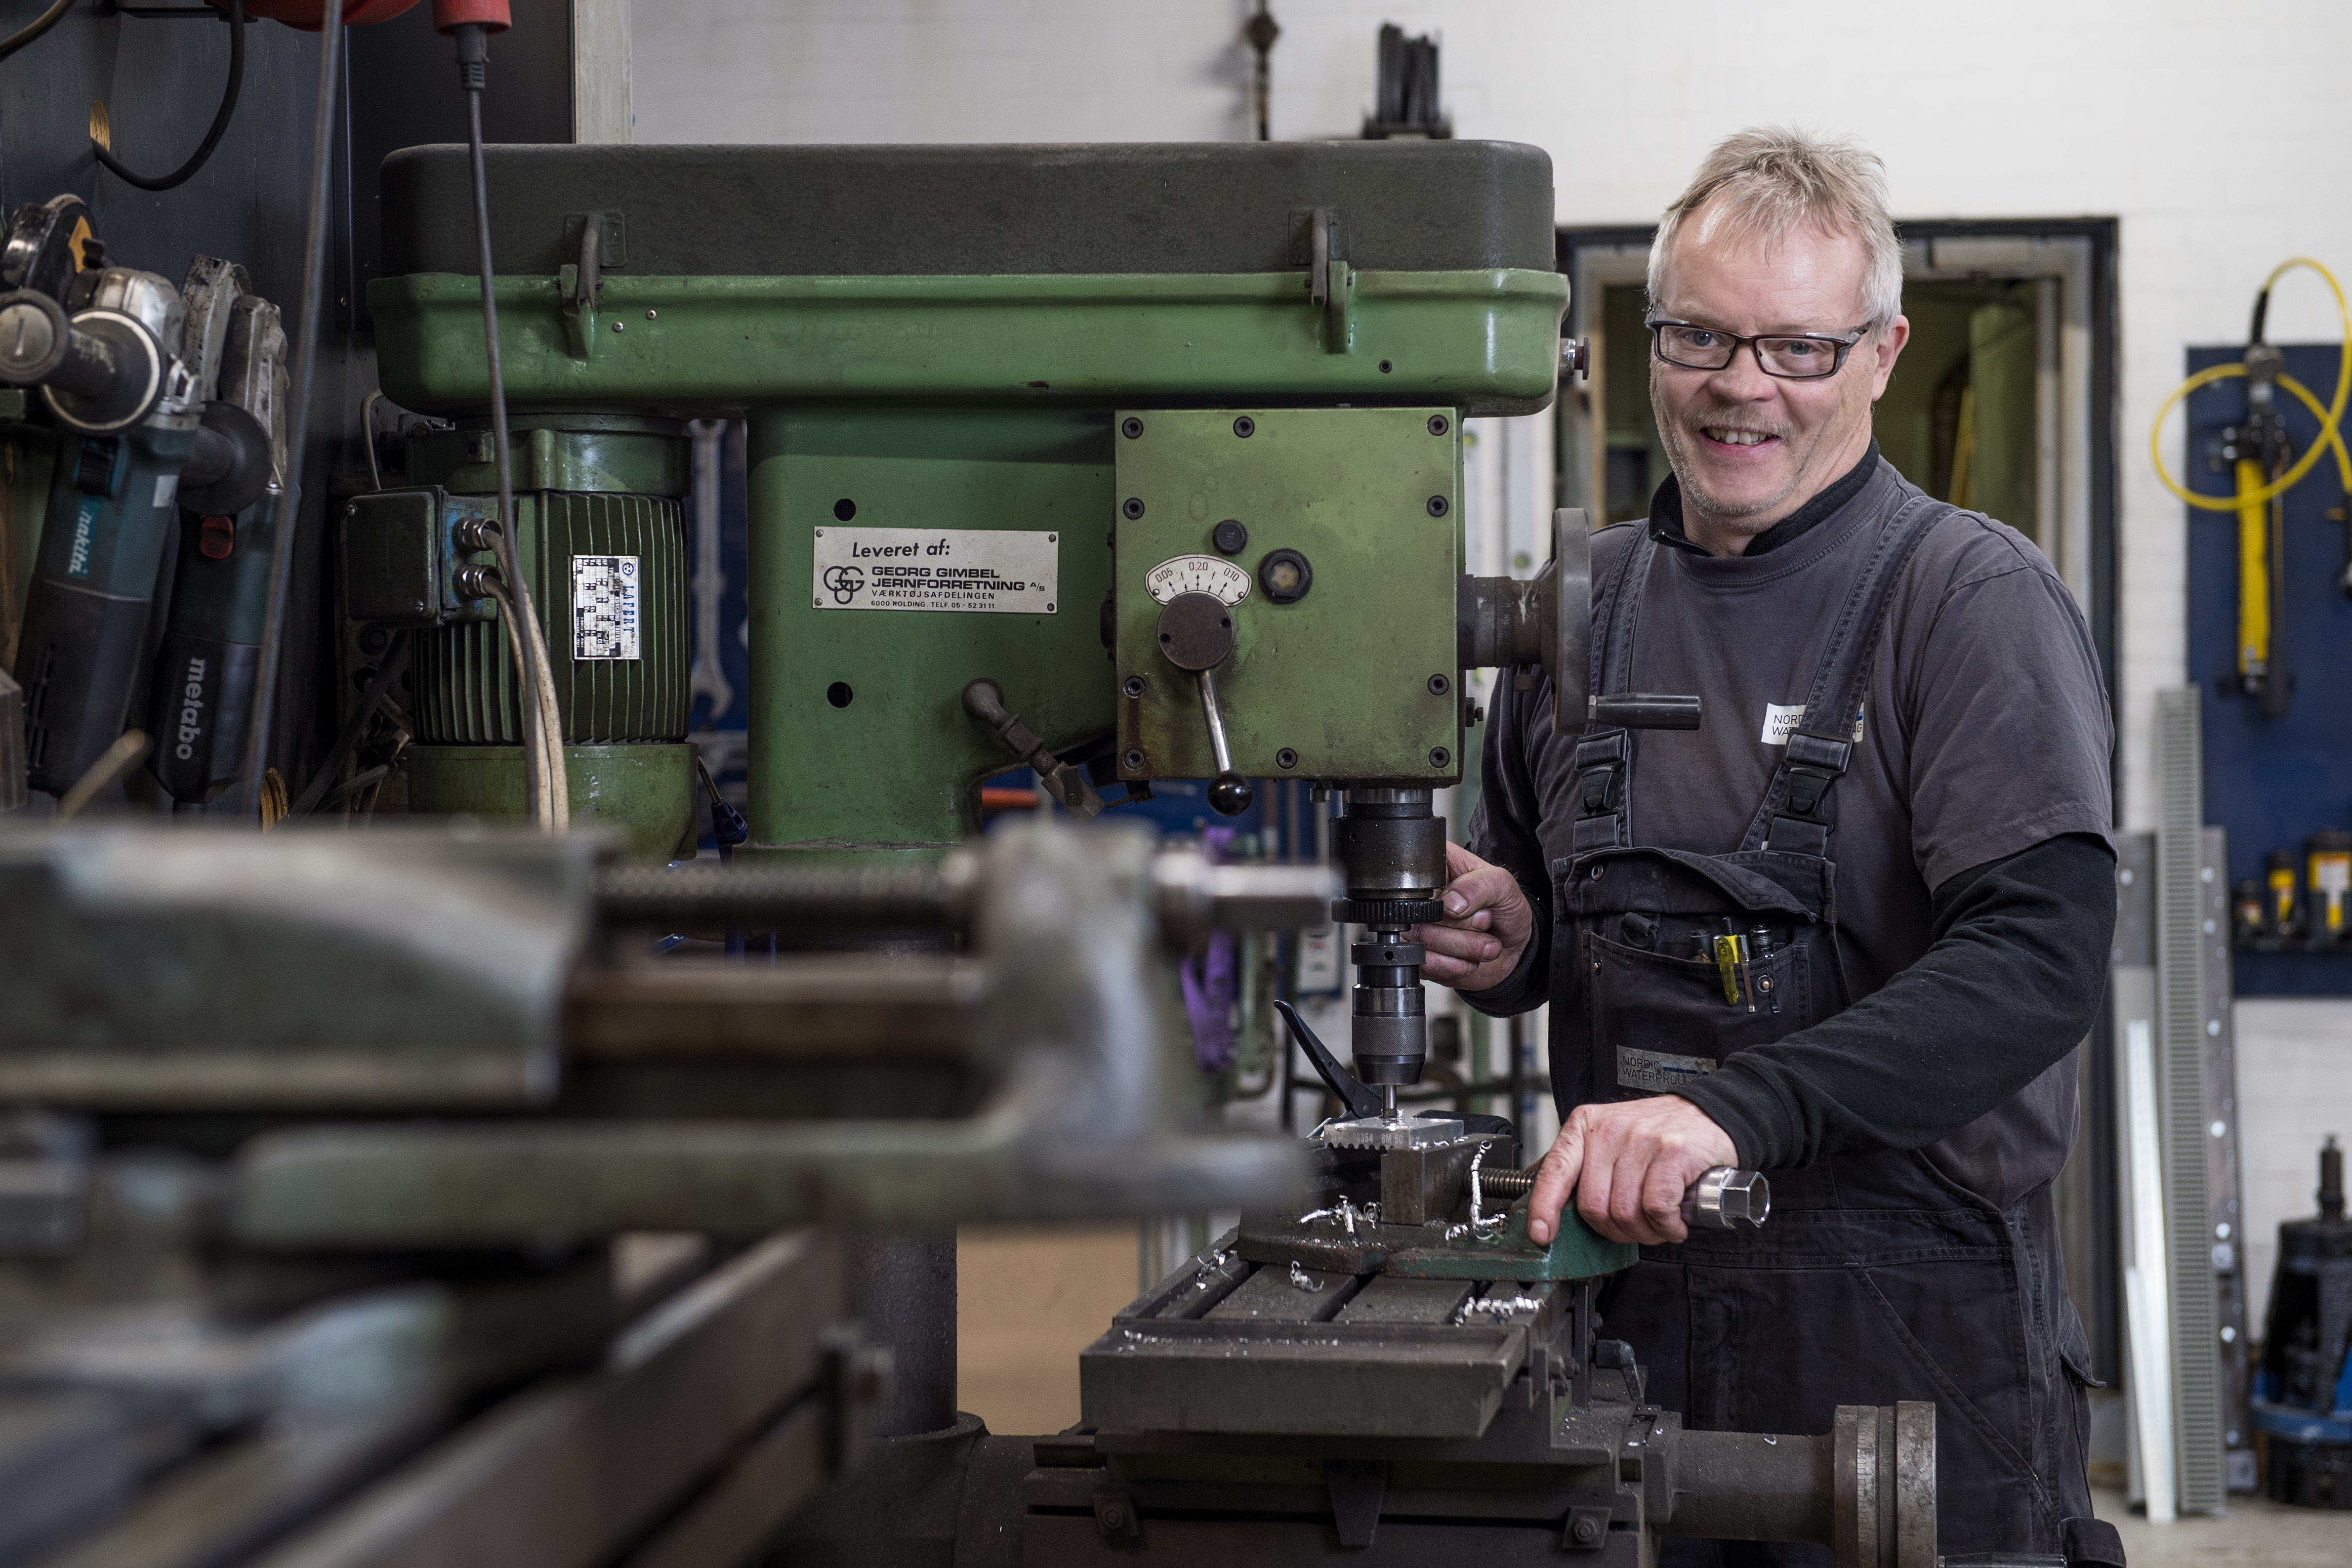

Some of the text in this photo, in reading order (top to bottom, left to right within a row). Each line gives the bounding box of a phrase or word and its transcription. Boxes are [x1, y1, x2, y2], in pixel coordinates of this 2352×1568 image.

[852, 538, 950, 557] Leveret af:
[871, 566, 1000, 578] GEORG GIMBEL
[1189, 562, 1208, 571] 0.20
[1155, 568, 1173, 582] 0.05
[1223, 568, 1239, 581] 0.10
[871, 578, 1025, 591] JERNFORRETNING
[871, 590, 994, 600] VÆRKTØJSAFDELINGEN
[623, 585, 634, 633] LAFERT
[176, 658, 206, 760] metabo
[1623, 1056, 1660, 1071] NORDIC
[1382, 1133, 1392, 1144] 8M
[1395, 1134, 1403, 1145] 50
